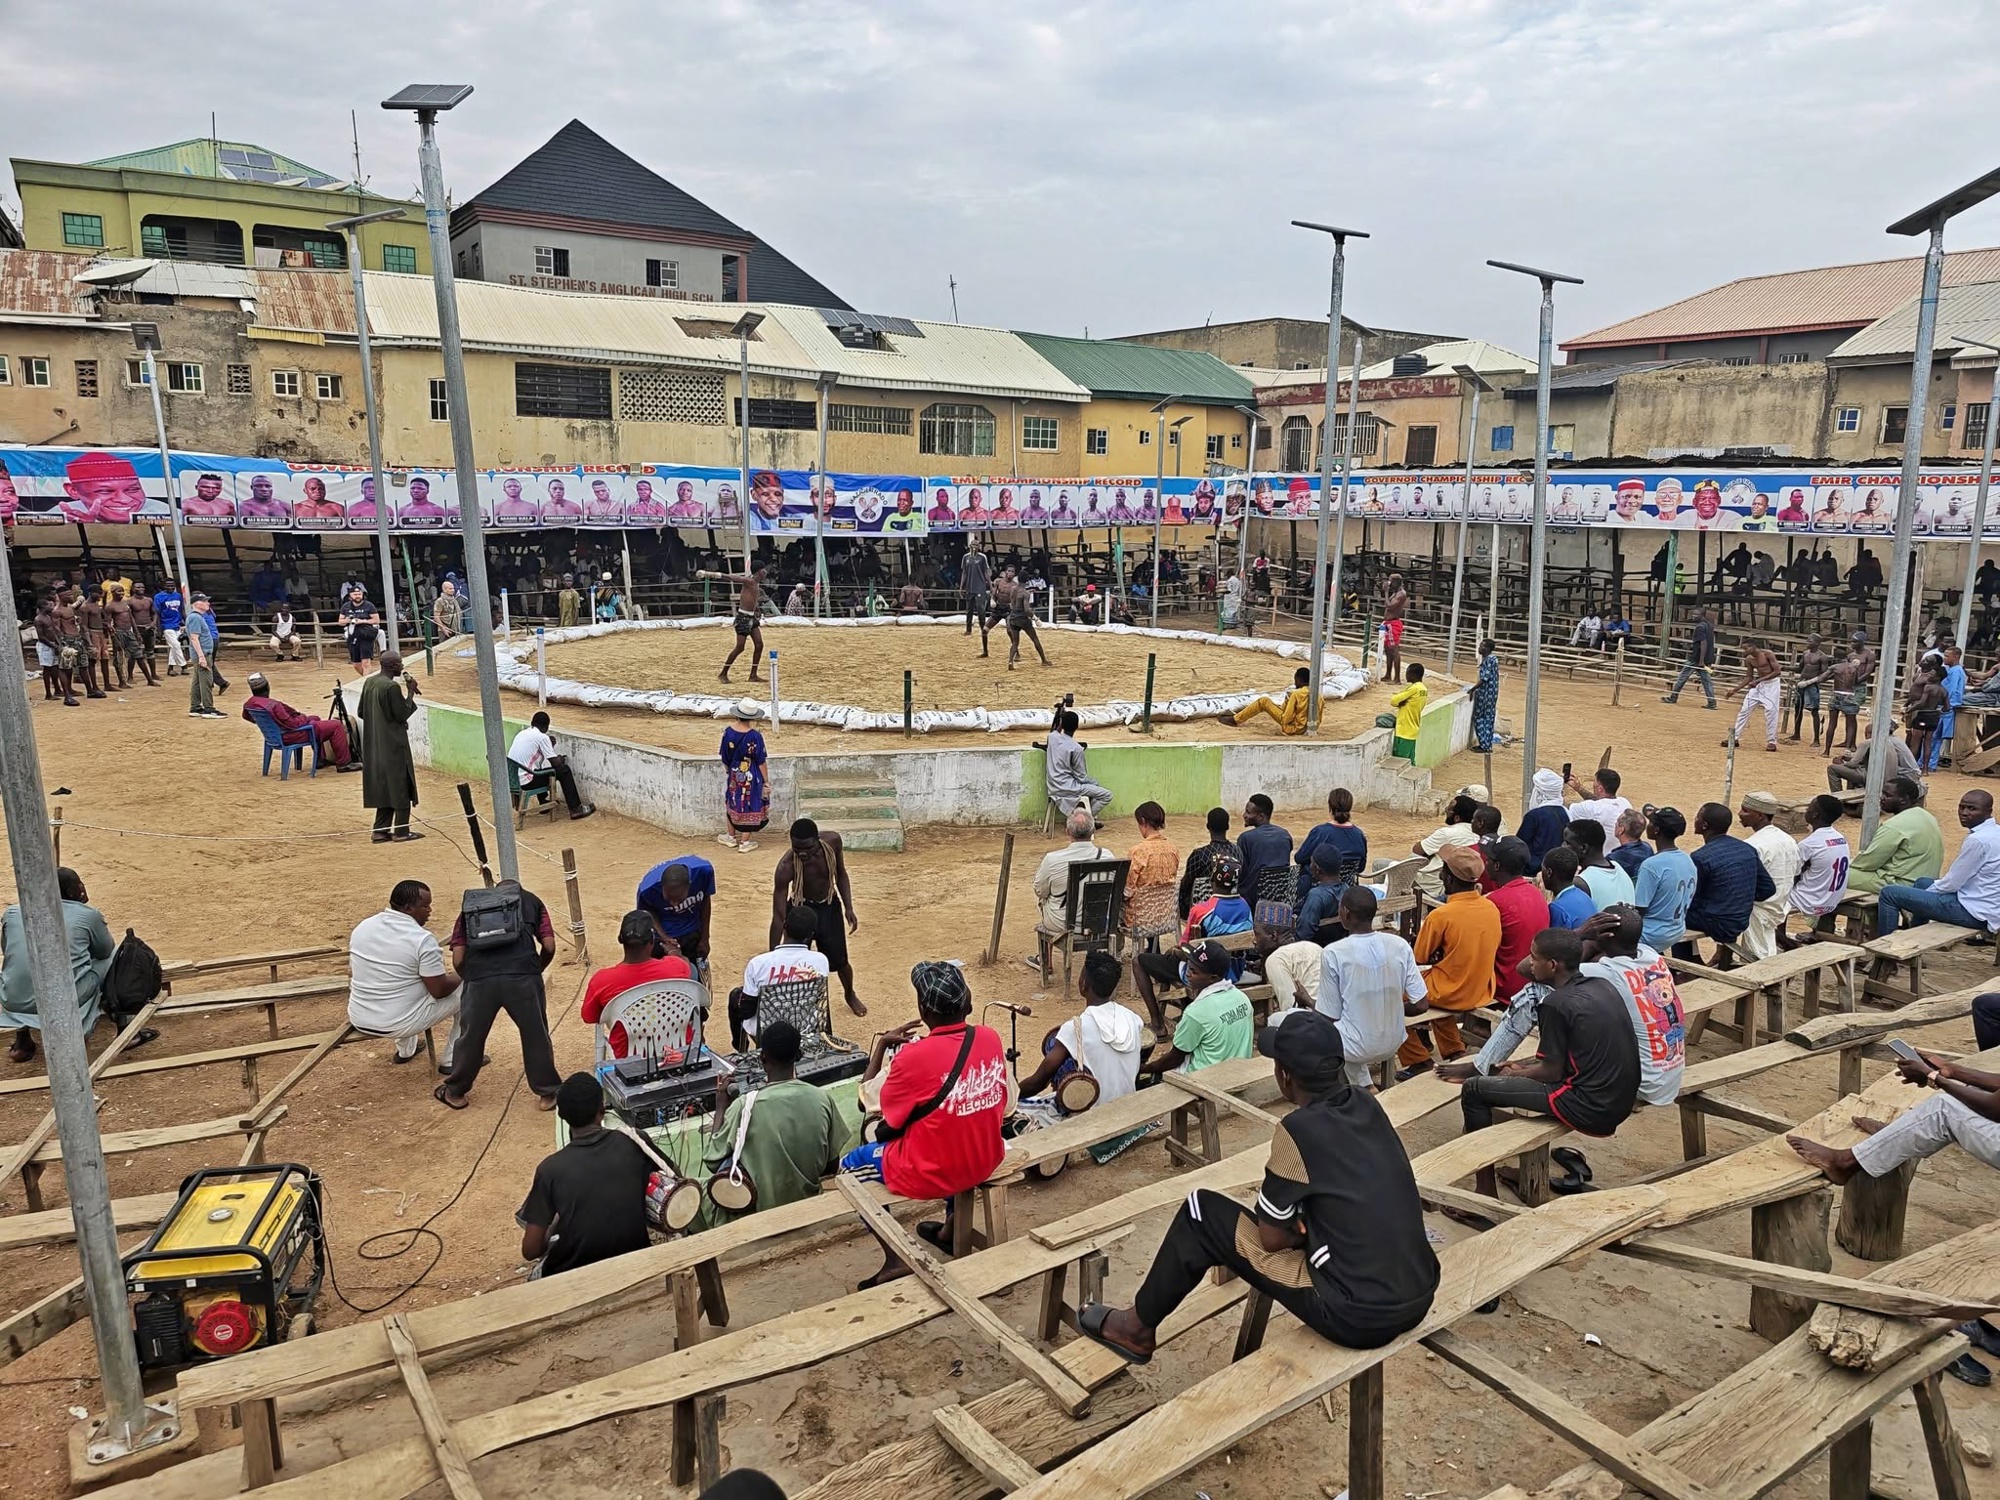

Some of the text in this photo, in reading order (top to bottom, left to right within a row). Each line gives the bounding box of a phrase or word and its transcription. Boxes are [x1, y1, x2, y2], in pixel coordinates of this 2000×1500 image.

[509, 274, 527, 287] ST.
[530, 276, 597, 292] STEPHEN'S
[600, 282, 657, 298] ANGLICAN
[661, 289, 687, 301] HIGH
[583, 463, 656, 475] RECOD
[952, 477, 1143, 486] EMI CHAMPIONSHIP RECORD
[1364, 476, 1417, 484] GOVERNOR
[1504, 476, 1551, 484] RECD
[1810, 475, 2000, 486] EMIR CHAMIONSHP
[1828, 856, 1848, 892] 18
[956, 1088, 1003, 1114] RECORDS
